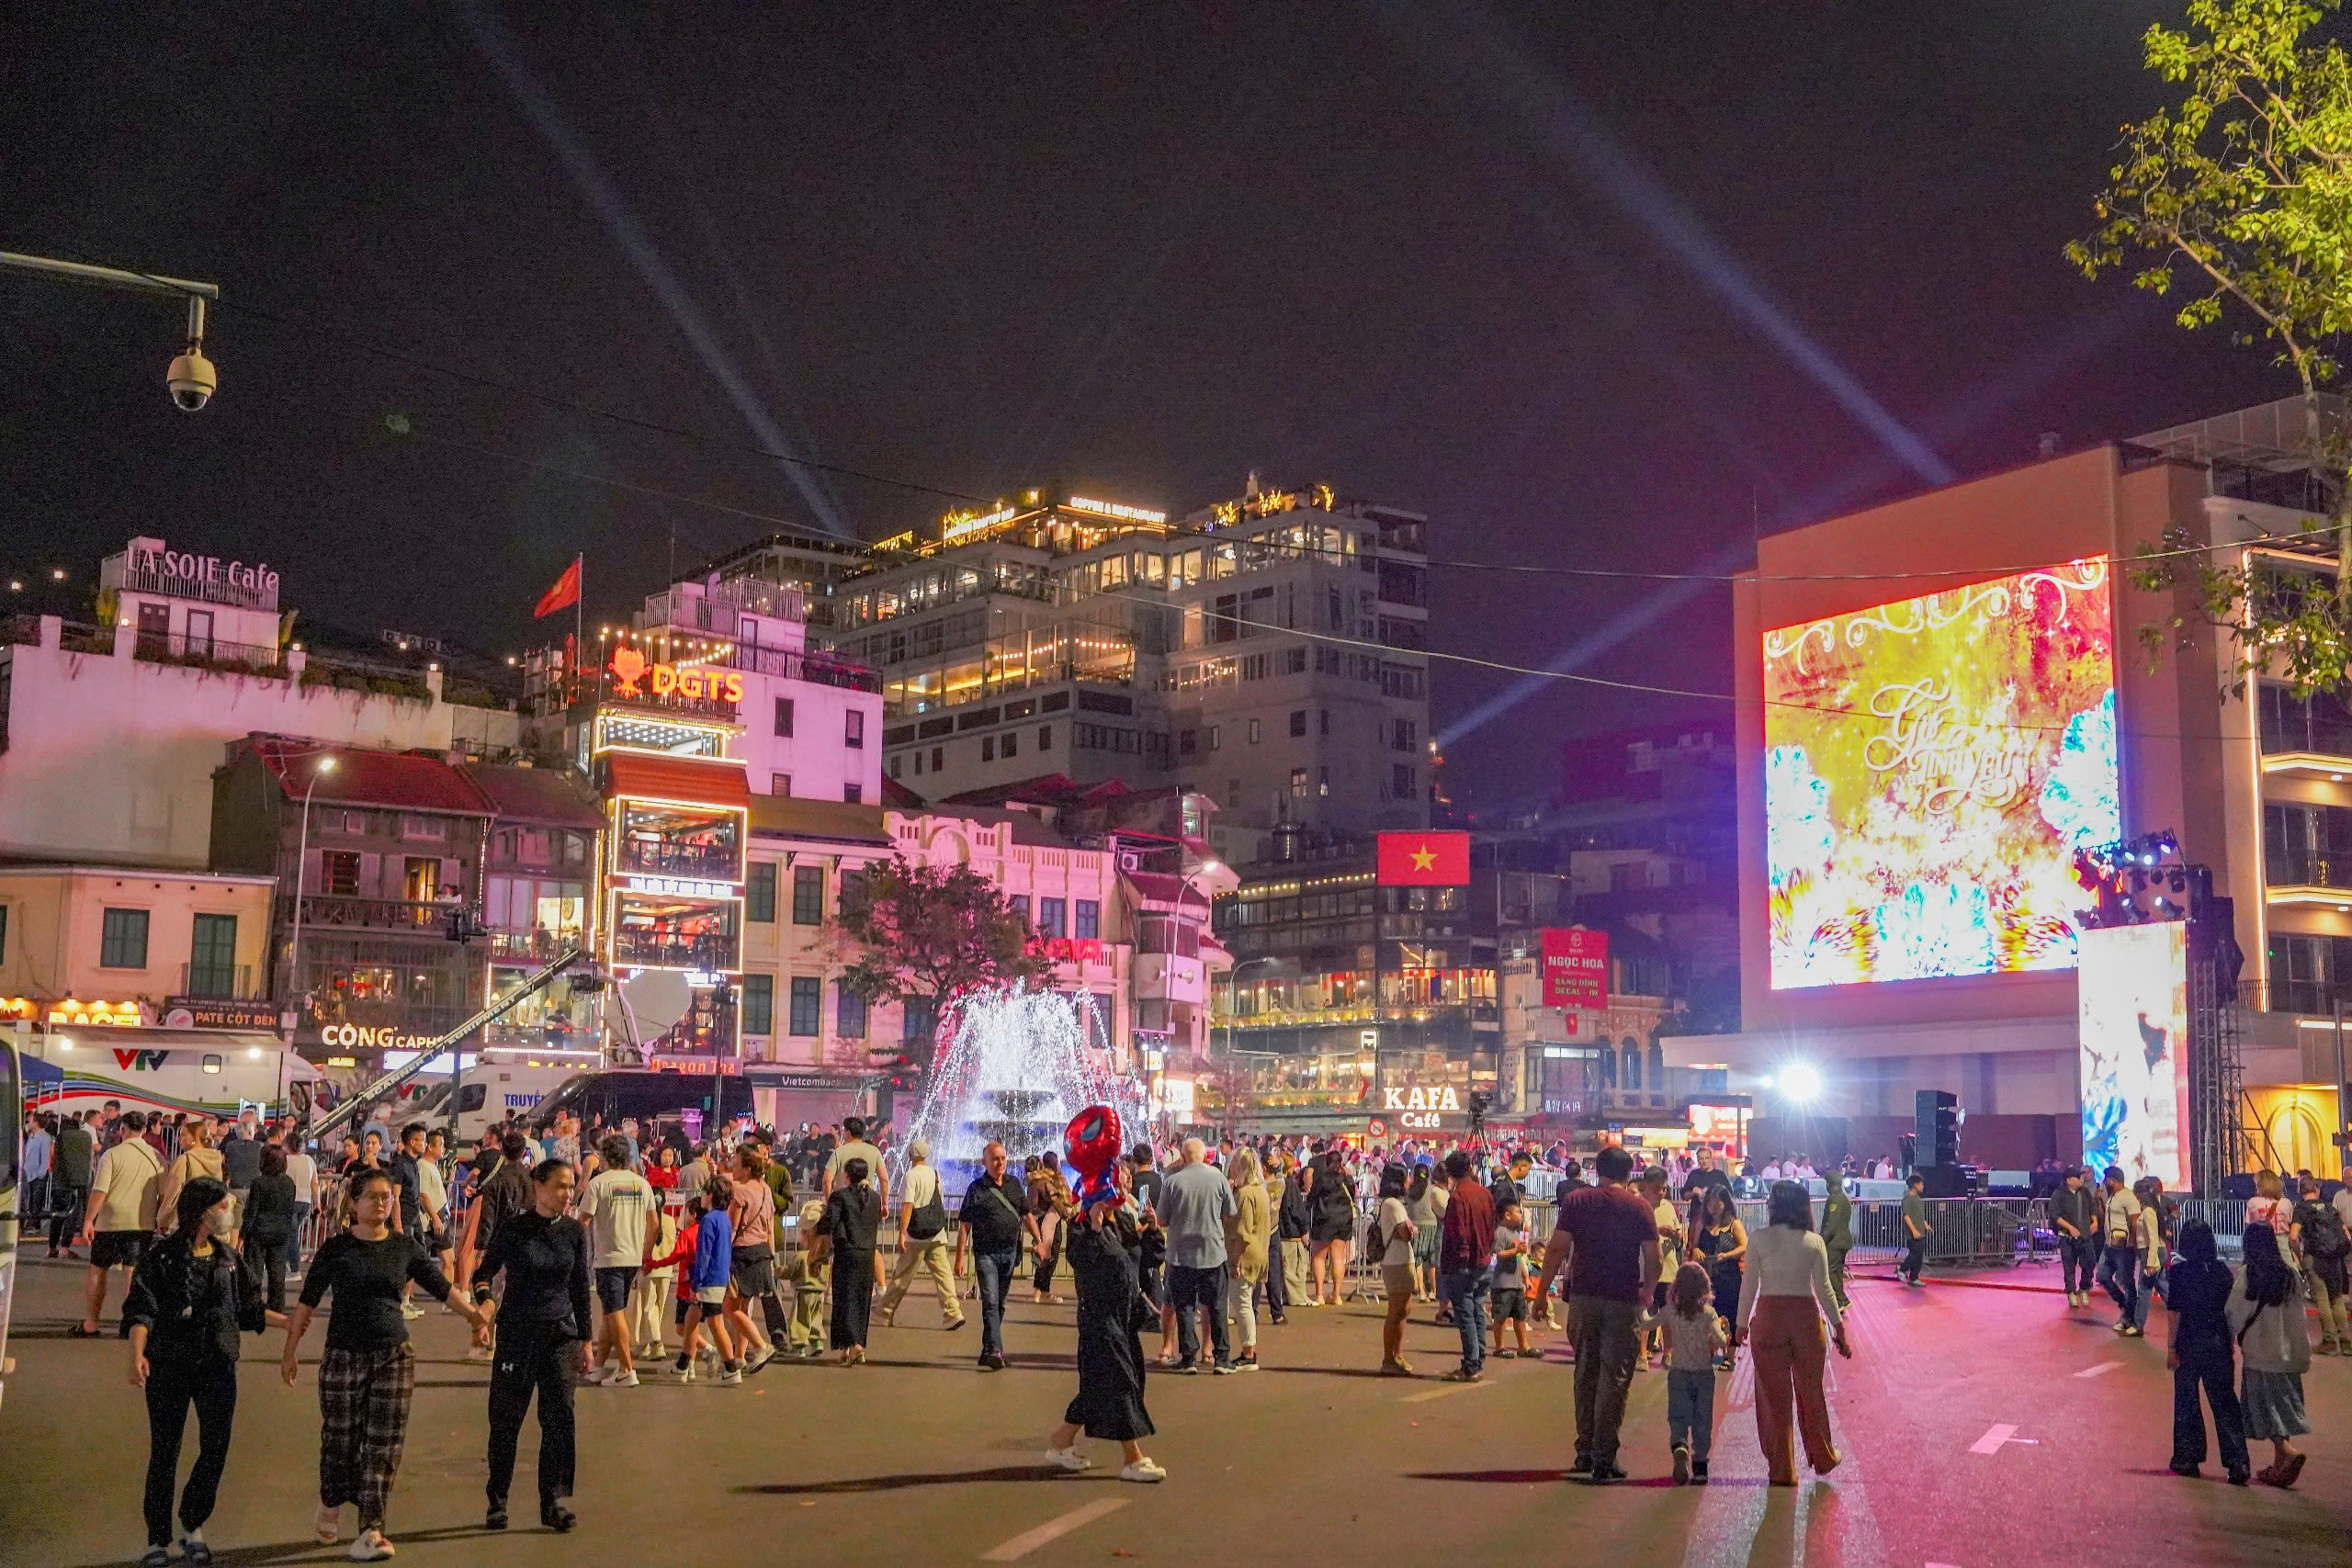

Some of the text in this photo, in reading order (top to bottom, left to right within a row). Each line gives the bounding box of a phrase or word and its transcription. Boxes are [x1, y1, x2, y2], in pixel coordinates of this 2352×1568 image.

[128, 546, 279, 591] LA SOIE Cafe
[652, 663, 744, 703] DGTS
[1582, 958, 1604, 969] HOA
[196, 1011, 224, 1024] PATE
[322, 1022, 394, 1051] CỘNG
[112, 1048, 171, 1071] VTV
[1383, 1087, 1460, 1110] KAFA
[1401, 1111, 1441, 1128] Café
